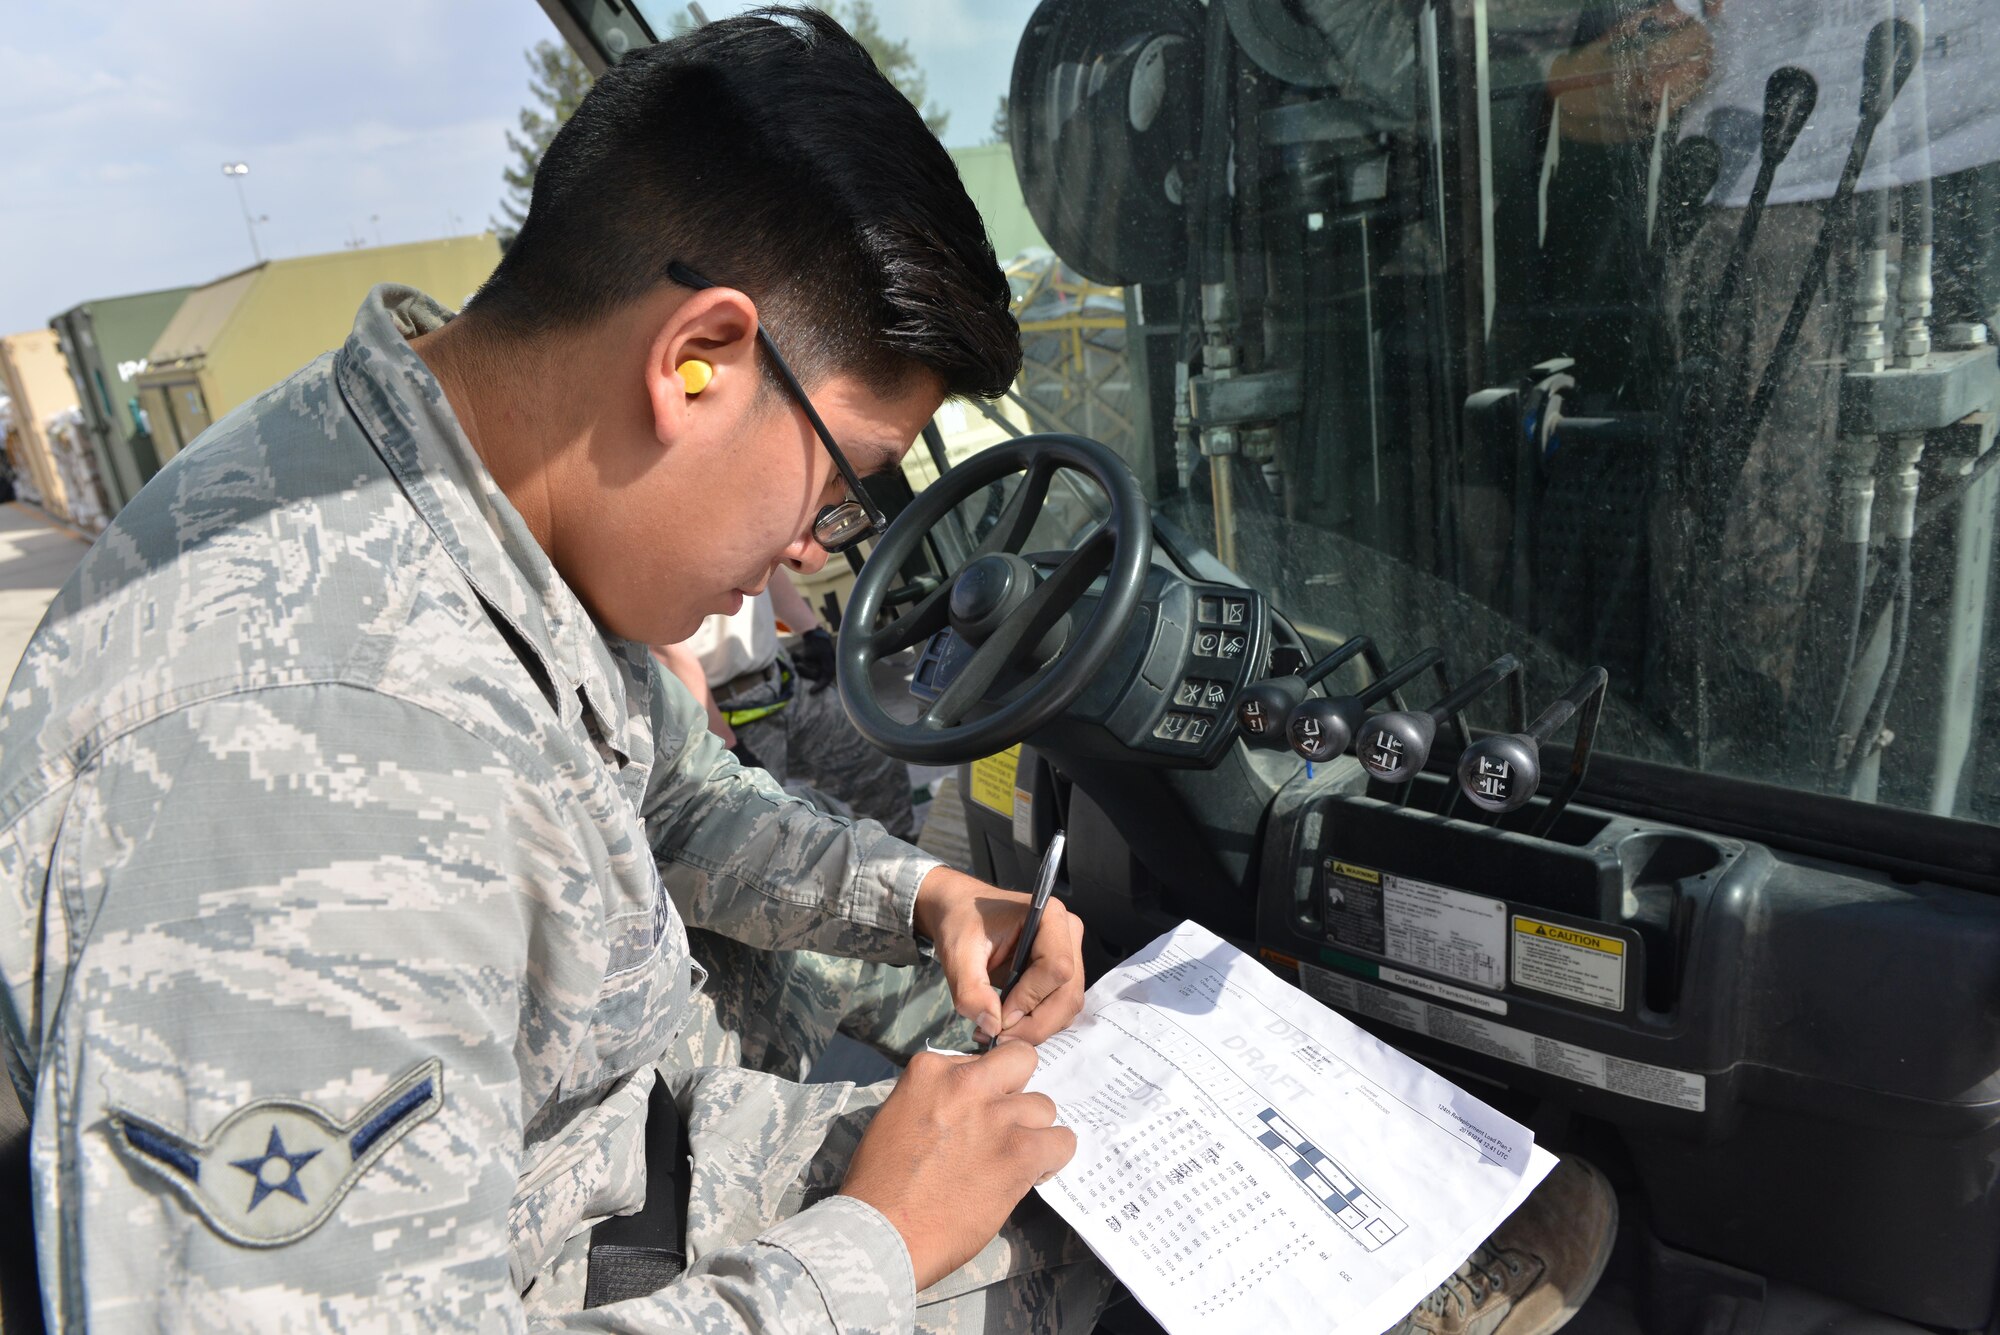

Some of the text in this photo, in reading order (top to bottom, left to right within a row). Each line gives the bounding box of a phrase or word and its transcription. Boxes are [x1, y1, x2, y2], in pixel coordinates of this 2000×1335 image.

[1345, 867, 1378, 880] WARNING
[1549, 928, 1600, 948] CAUTION
[1395, 974, 1491, 1008] DuraMatch Transmission
[1221, 1034, 1315, 1105] DRAFT
[1437, 1103, 1451, 1115] 124th
[1451, 1112, 1485, 1136] Redeployment
[1485, 1133, 1496, 1143] Load
[1497, 1140, 1508, 1151] Plan
[1459, 1126, 1509, 1160] 20161014 12:41 UTC
[1067, 1192, 1078, 1202] USE
[1076, 1202, 1090, 1214] ONLY
[1216, 1142, 1224, 1150] WT
[1278, 1208, 1286, 1216] HZ
[1320, 1252, 1328, 1260] SH
[1340, 1271, 1352, 1282] CCC
